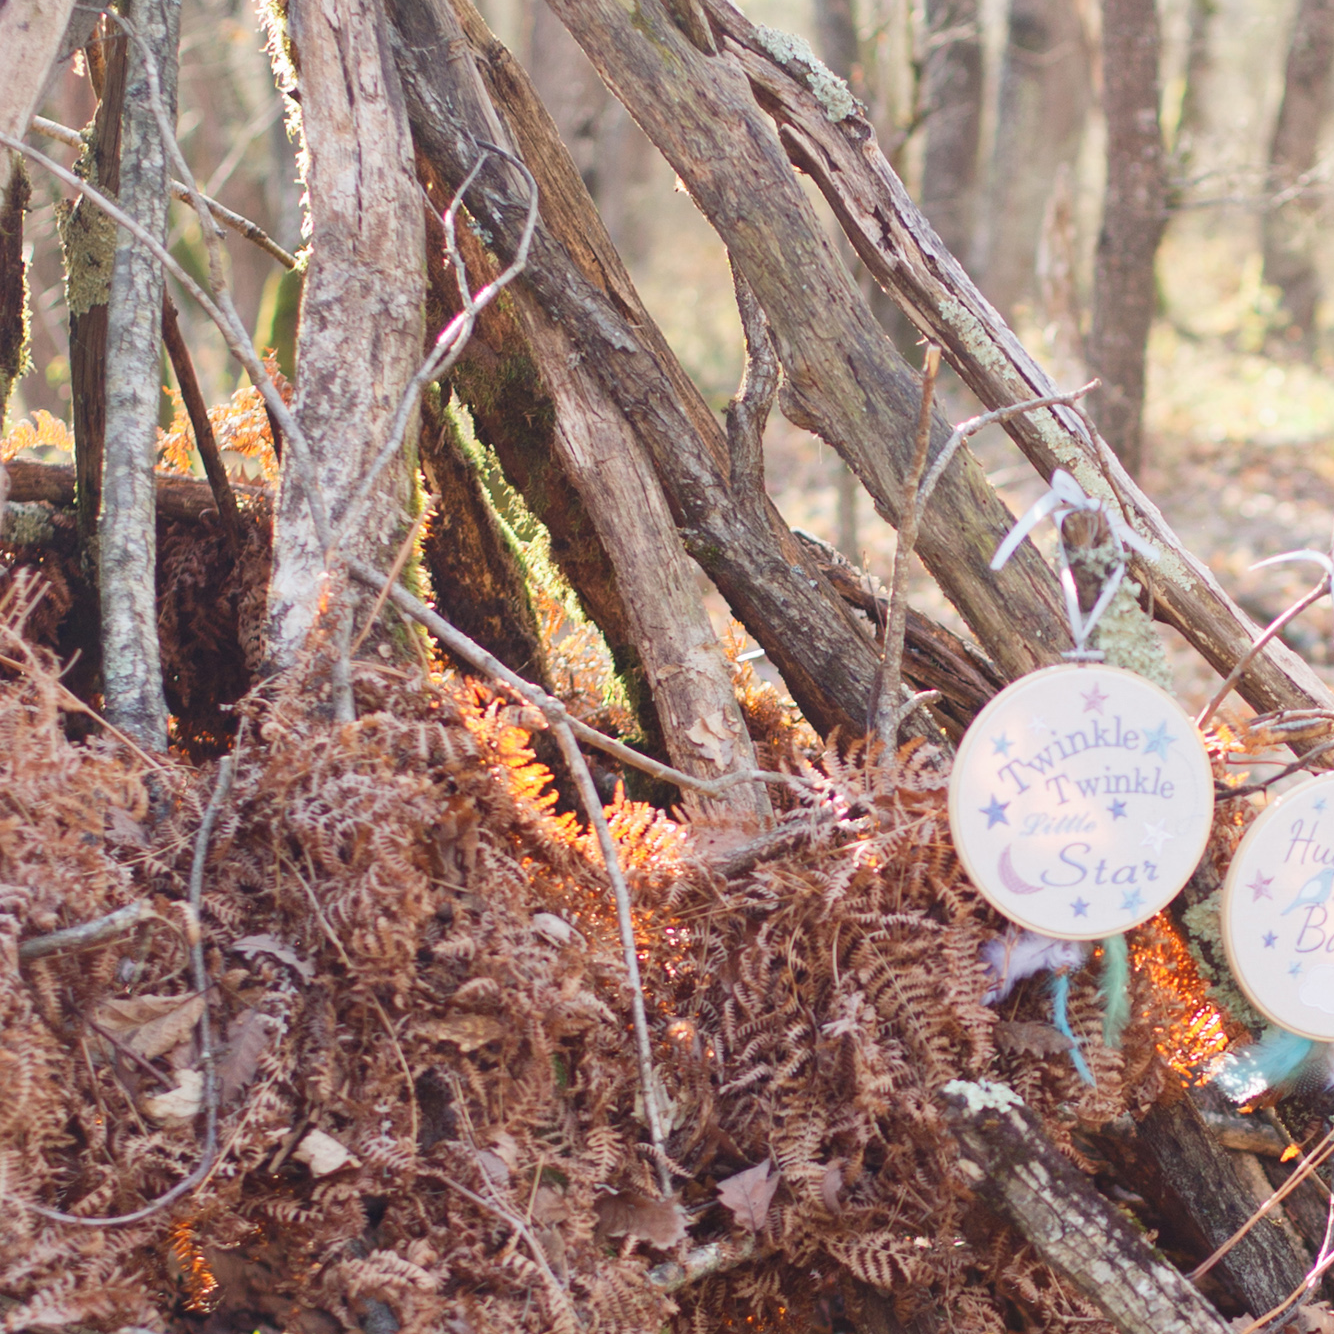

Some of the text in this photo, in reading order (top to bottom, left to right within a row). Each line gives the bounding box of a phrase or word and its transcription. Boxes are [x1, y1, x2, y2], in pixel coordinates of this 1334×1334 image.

[997, 715, 1140, 795] Twinkle
[1045, 766, 1174, 806] Twinkle
[1018, 811, 1098, 837] Little
[1039, 842, 1159, 887] Star
